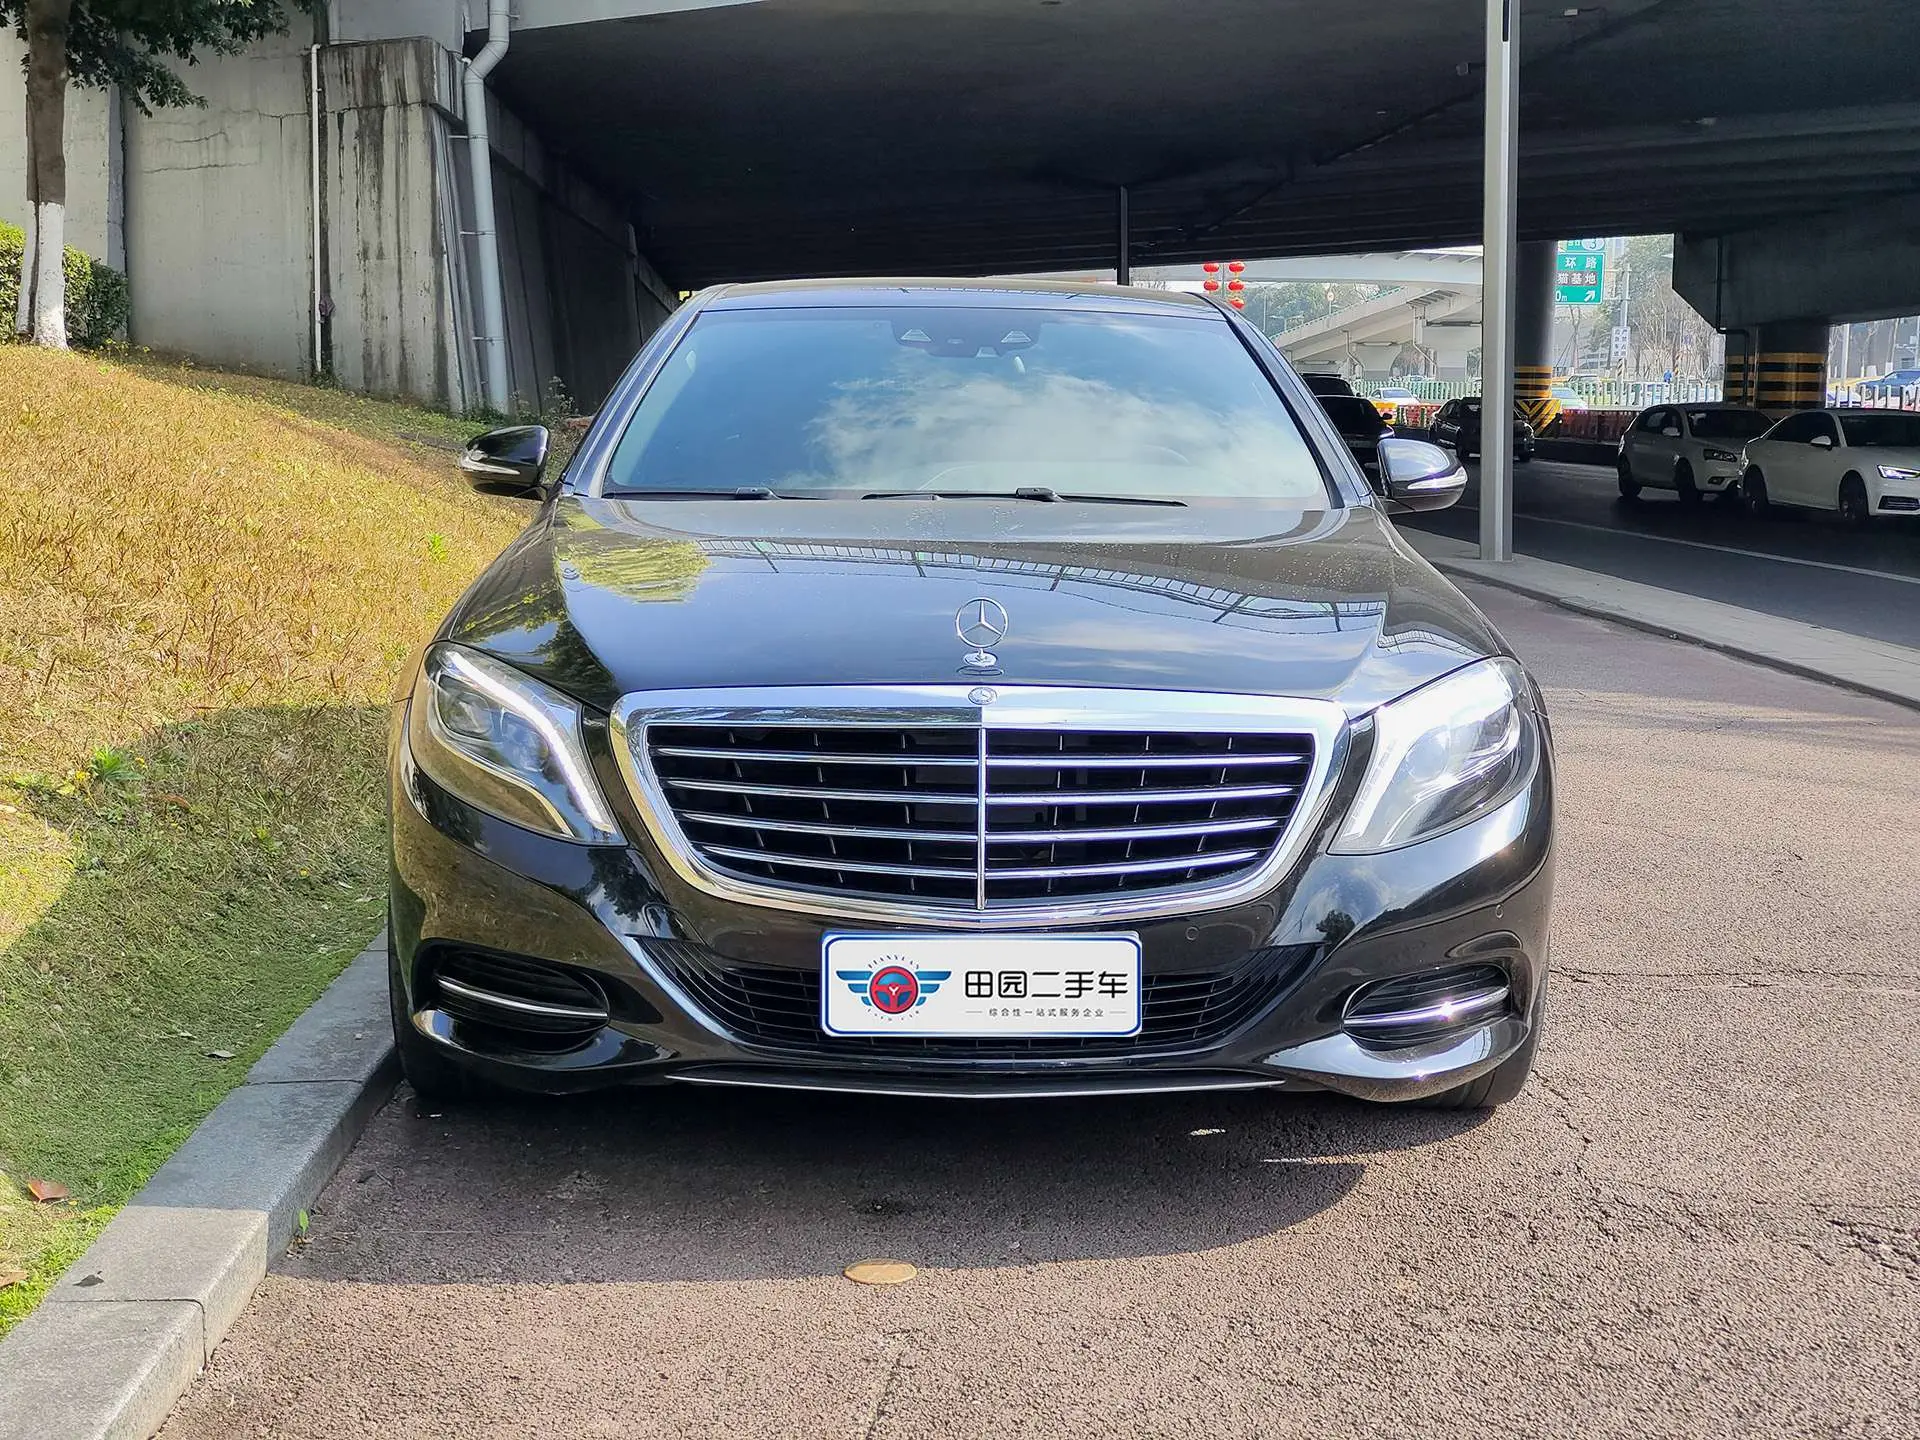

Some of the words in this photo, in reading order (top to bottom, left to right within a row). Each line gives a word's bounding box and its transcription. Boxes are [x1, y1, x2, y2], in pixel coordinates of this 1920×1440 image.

[1565, 256, 1597, 269] 环路
[888, 985, 900, 996] Y
[965, 970, 1129, 999] 田园二手车
[988, 1008, 1105, 1018] 综合性一站式服务企业
